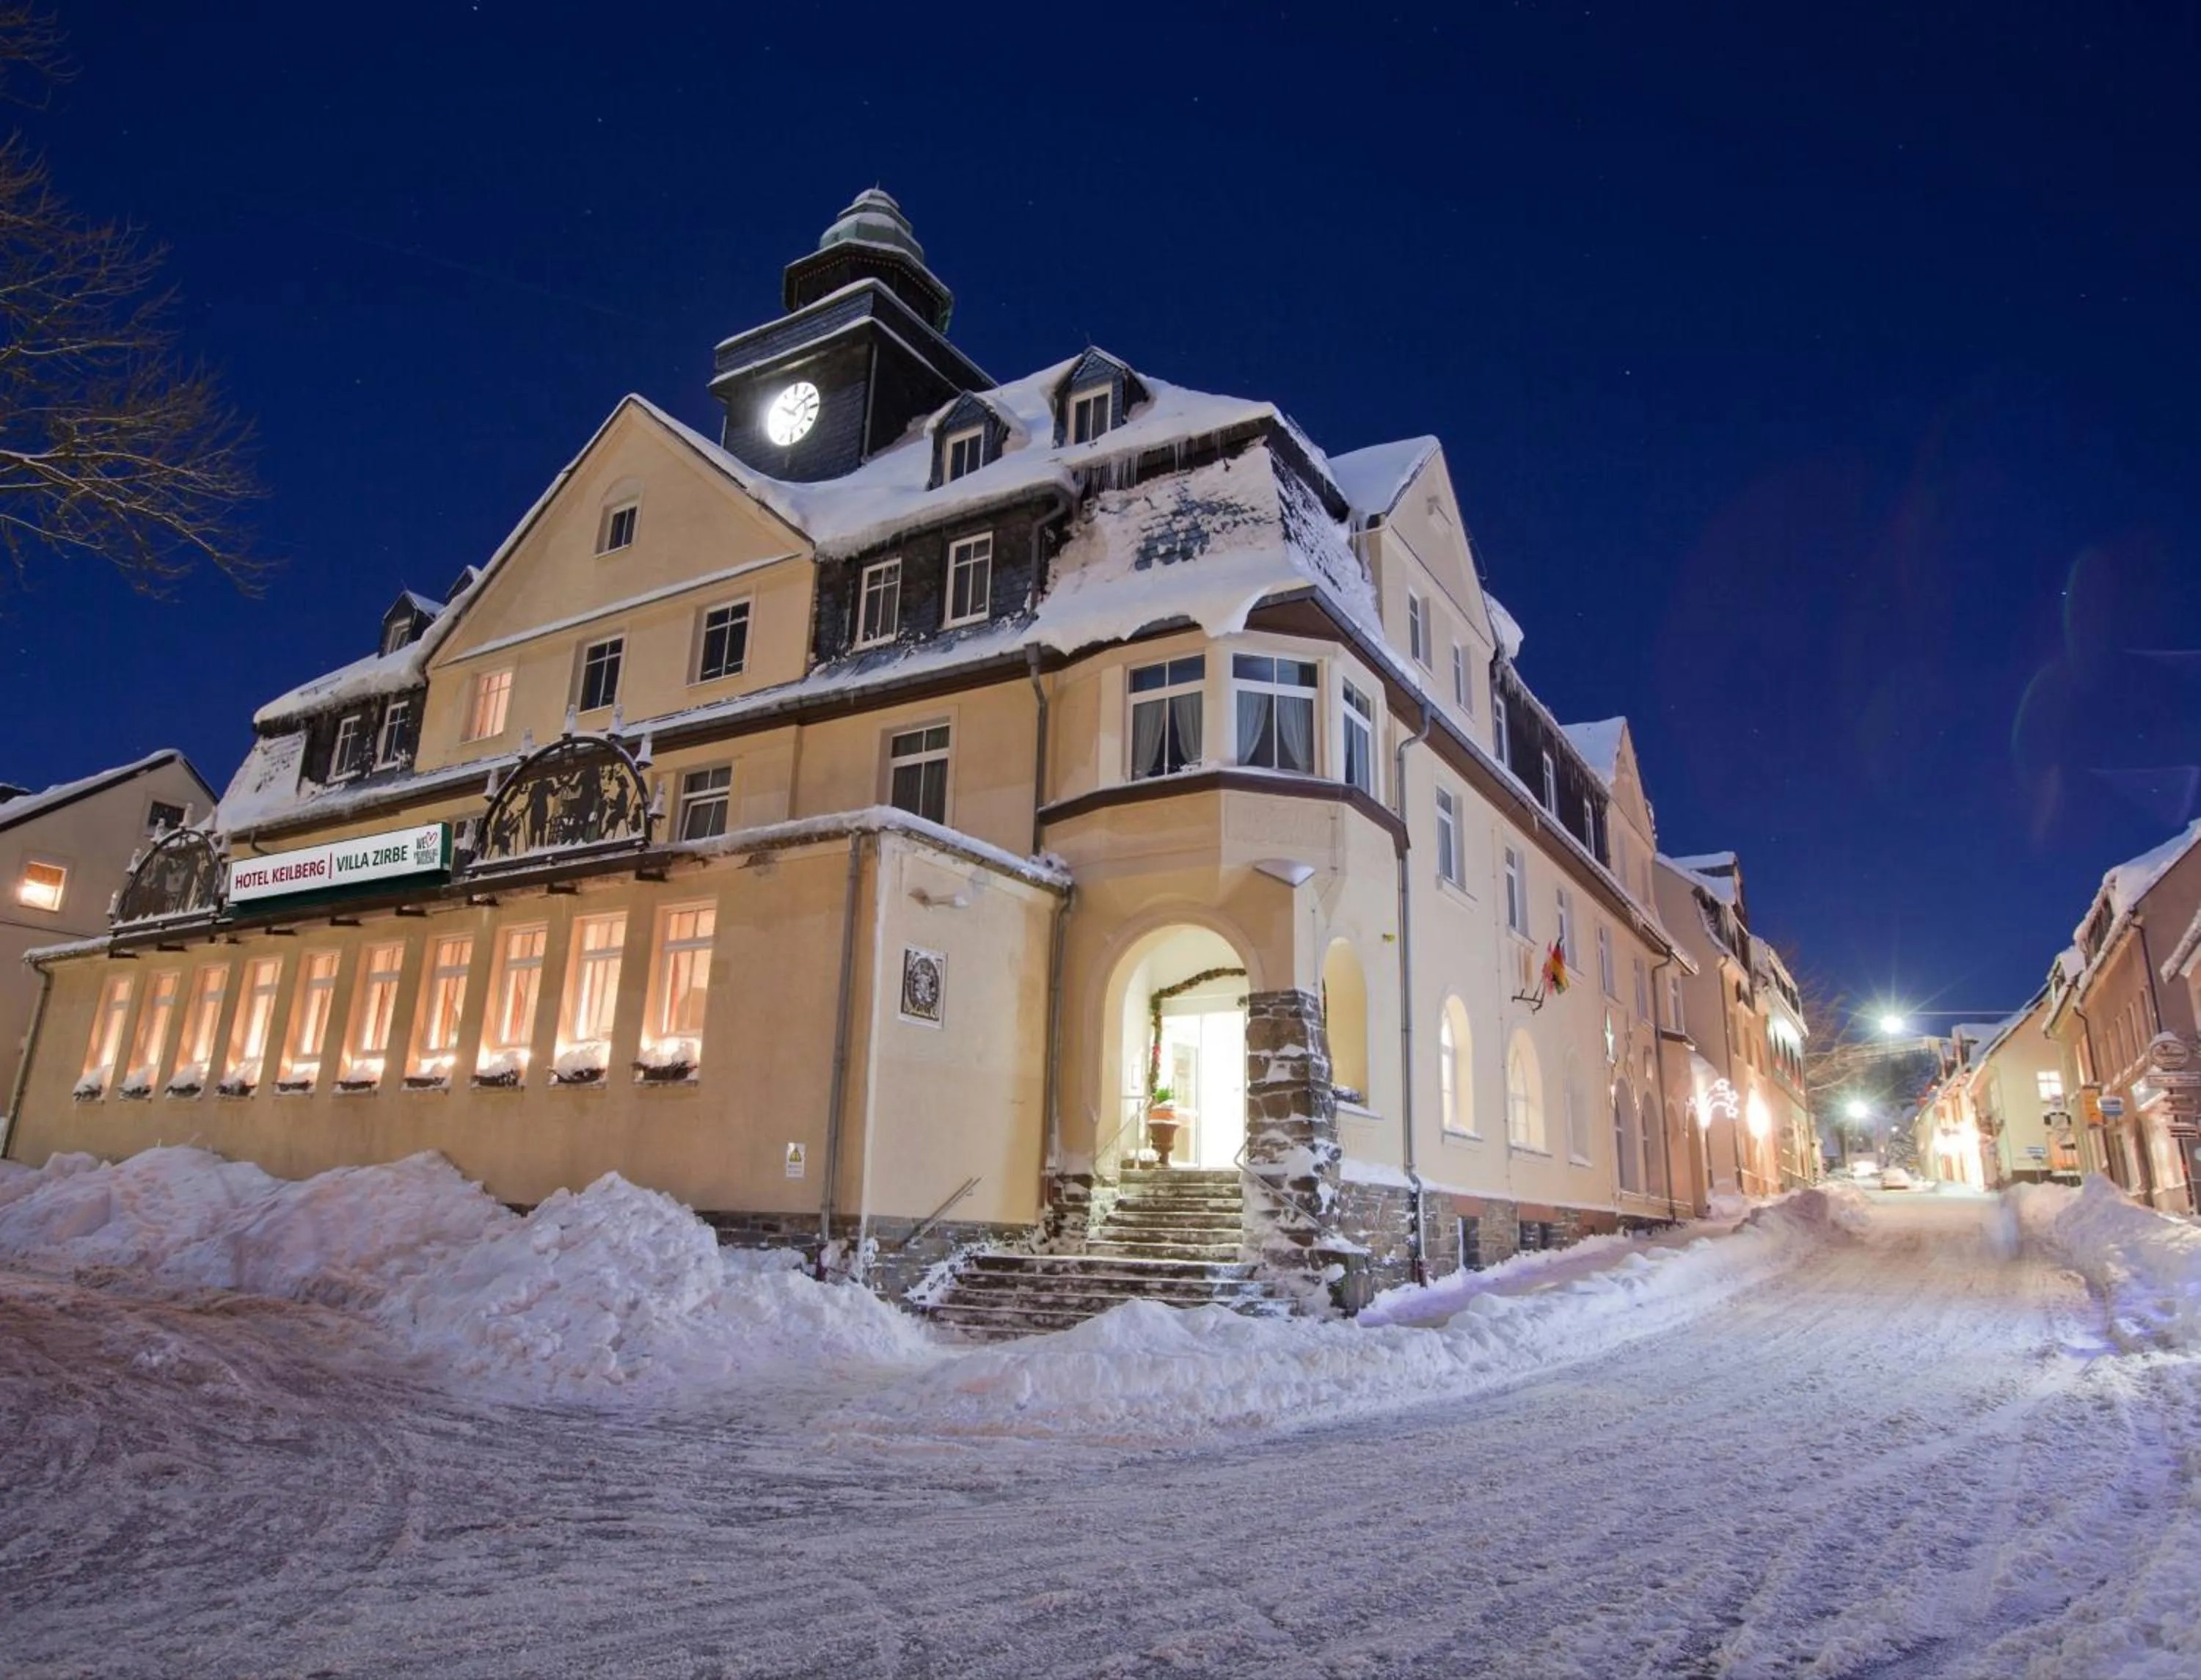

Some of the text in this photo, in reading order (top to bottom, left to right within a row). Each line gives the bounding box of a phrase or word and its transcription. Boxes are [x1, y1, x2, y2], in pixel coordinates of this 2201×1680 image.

[235, 870, 269, 889] HOTEL
[272, 860, 325, 883] KEILBERG
[337, 852, 369, 872] VILLA
[373, 845, 409, 866] ZIRBE
